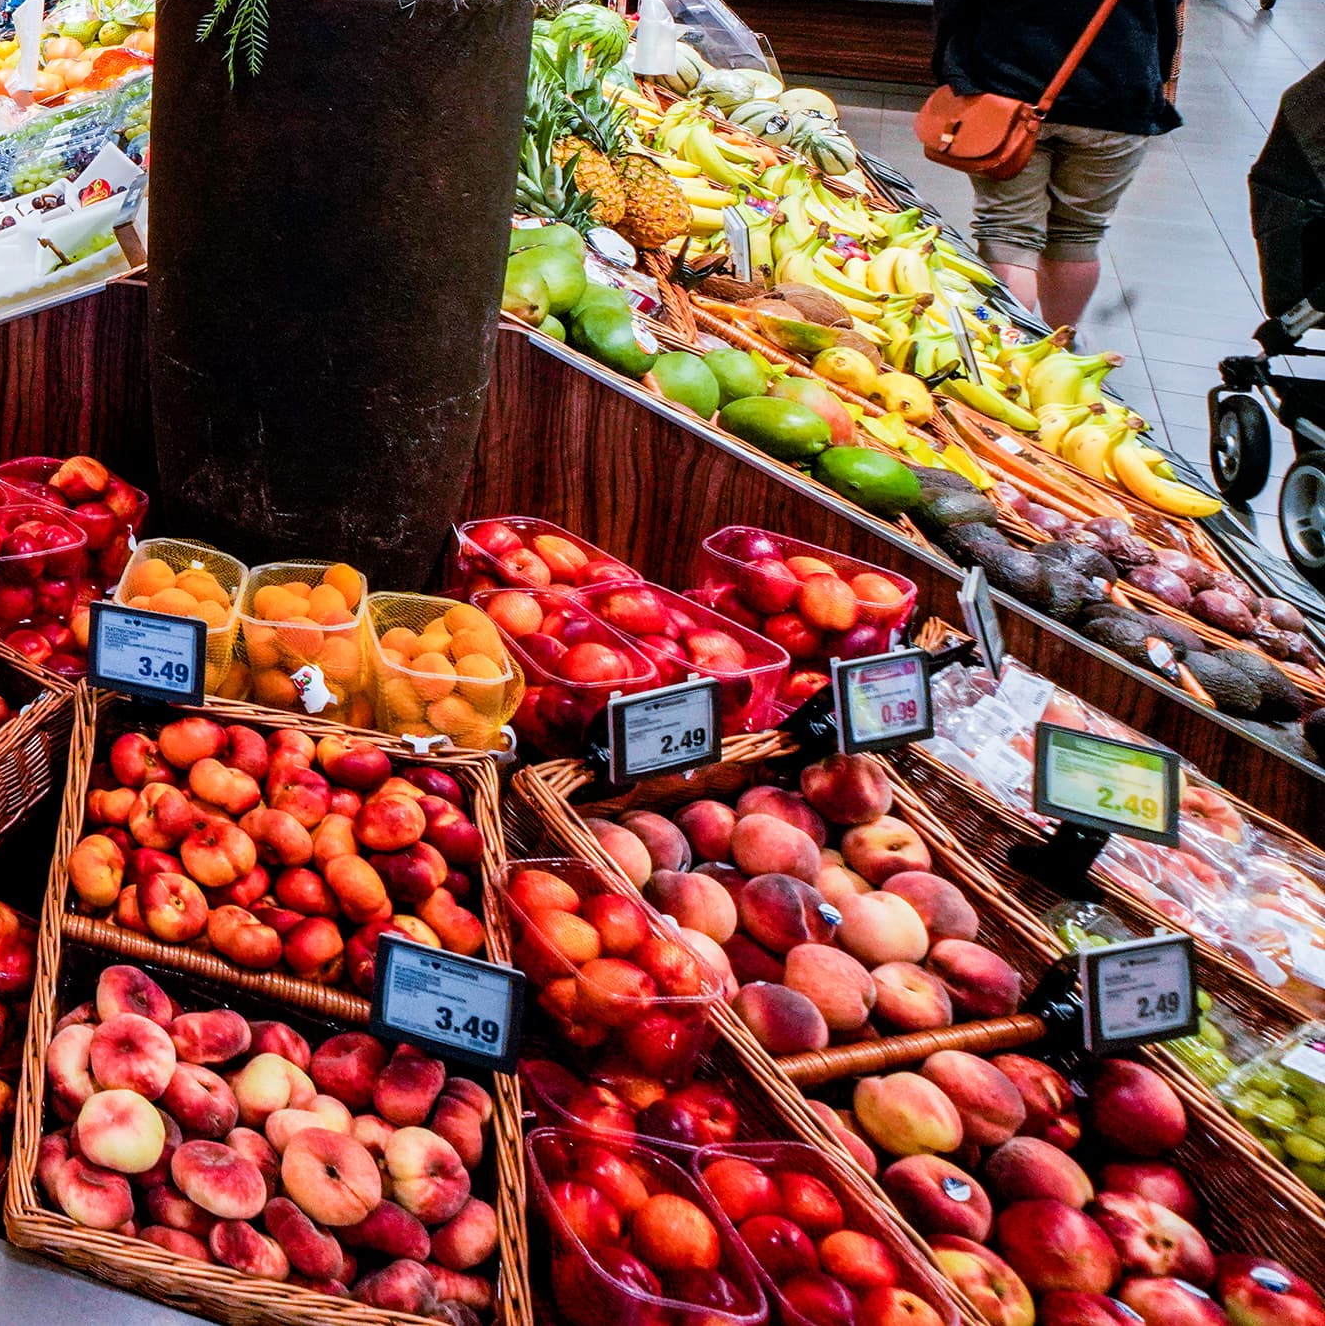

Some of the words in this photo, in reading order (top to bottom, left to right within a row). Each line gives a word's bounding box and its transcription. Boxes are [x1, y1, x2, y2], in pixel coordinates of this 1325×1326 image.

[138, 656, 189, 684] 3.49
[881, 699, 917, 724] 0.99
[660, 727, 706, 755] 2.49
[1097, 786, 1158, 821] 2.49
[1137, 991, 1180, 1020] 2.49
[435, 1005, 500, 1045] 3.49
